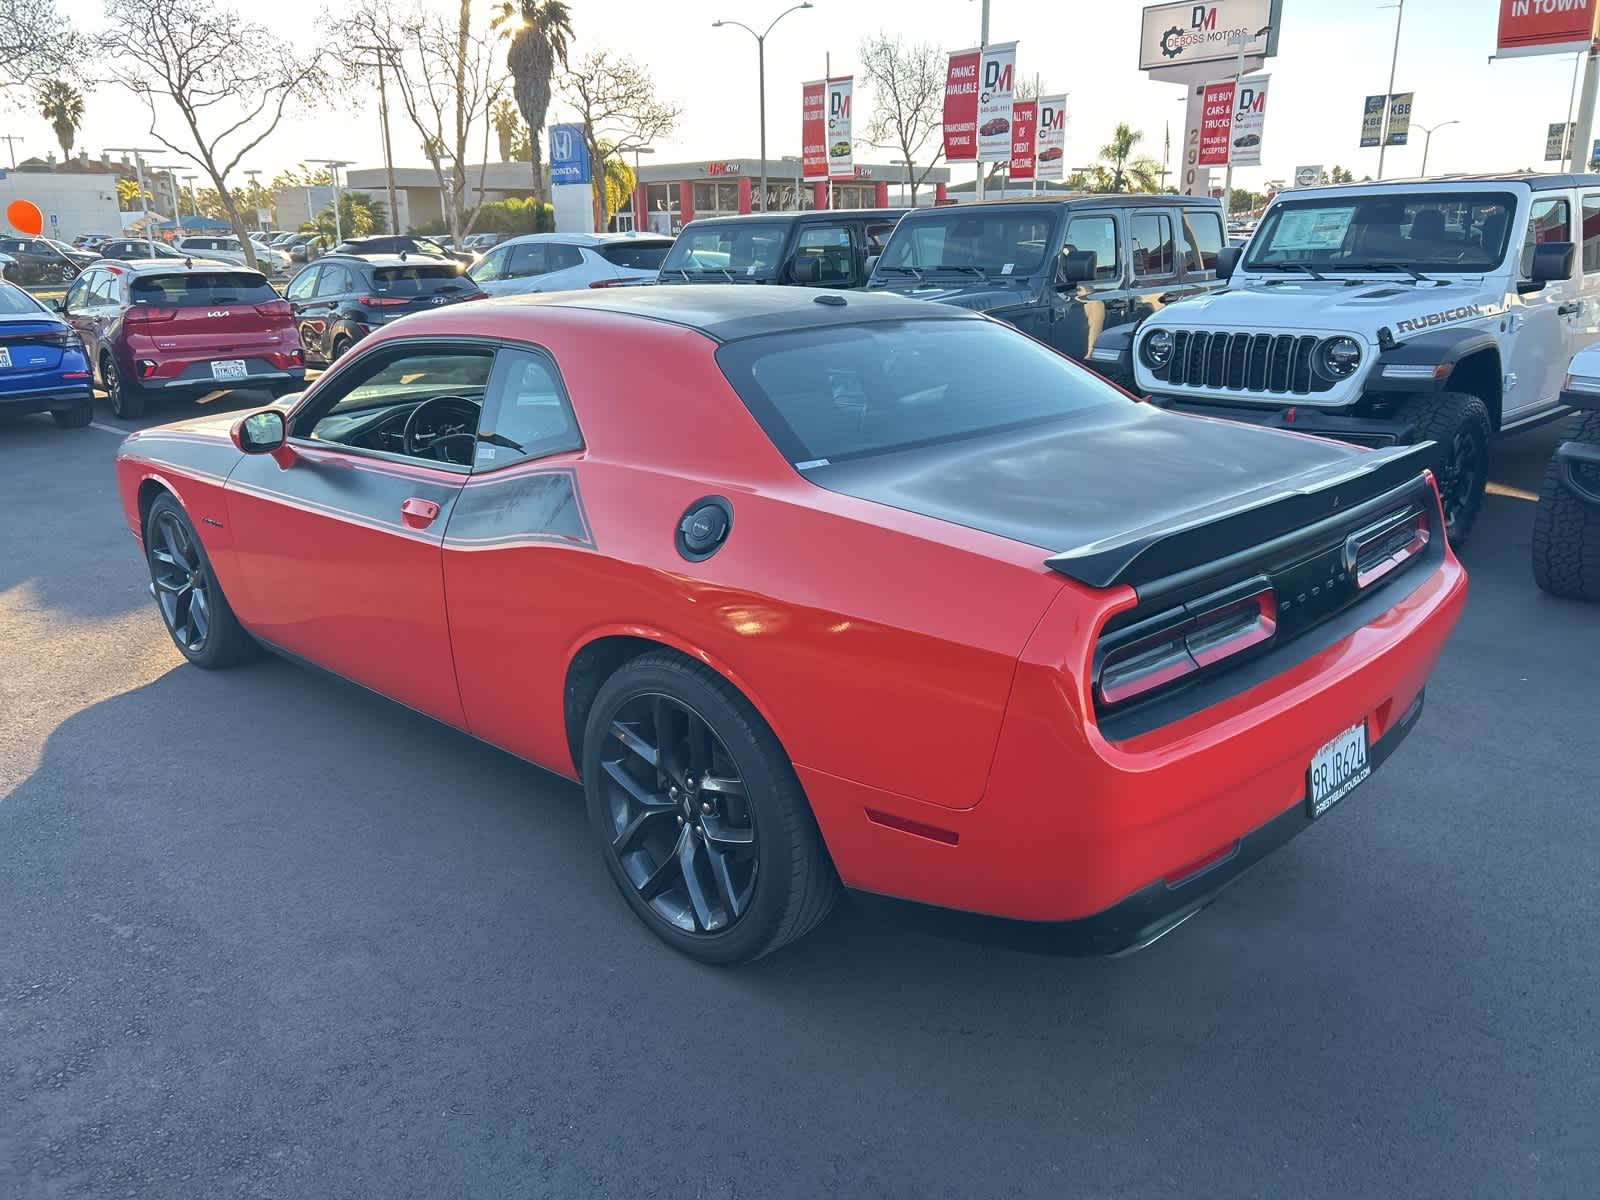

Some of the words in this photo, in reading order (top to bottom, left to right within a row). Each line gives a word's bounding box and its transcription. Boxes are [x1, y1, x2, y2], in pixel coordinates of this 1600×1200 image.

[1511, 0, 1529, 16] IN
[1533, 0, 1588, 15] TOWN
[1191, 5, 1217, 31] DM
[1167, 34, 1205, 48] DEBOSS
[1207, 28, 1248, 42] MOTORS
[951, 65, 976, 79] FINANCE
[984, 61, 1013, 93] DM
[946, 82, 977, 95] AVAILABLE
[1207, 93, 1218, 102] WE
[1219, 92, 1232, 102] BUY
[1239, 88, 1265, 113] DM
[831, 91, 850, 119] DM
[1206, 106, 1225, 116] CARS
[1226, 105, 1231, 113] &
[1390, 103, 1411, 115] KBB
[1013, 112, 1022, 122] ALL
[1022, 111, 1033, 121] TYPE
[1041, 107, 1064, 131] DM
[1205, 119, 1230, 129] TRUCKS
[1018, 127, 1026, 137] OF
[1013, 142, 1030, 153] CREDIT
[1201, 146, 1227, 155] ACCEPTED
[1010, 158, 1033, 169] WELCOME
[550, 167, 580, 176] HONDA
[1397, 304, 1481, 333] RUBICON
[1280, 573, 1345, 611] DODGE
[1313, 736, 1365, 801] 9RJR624
